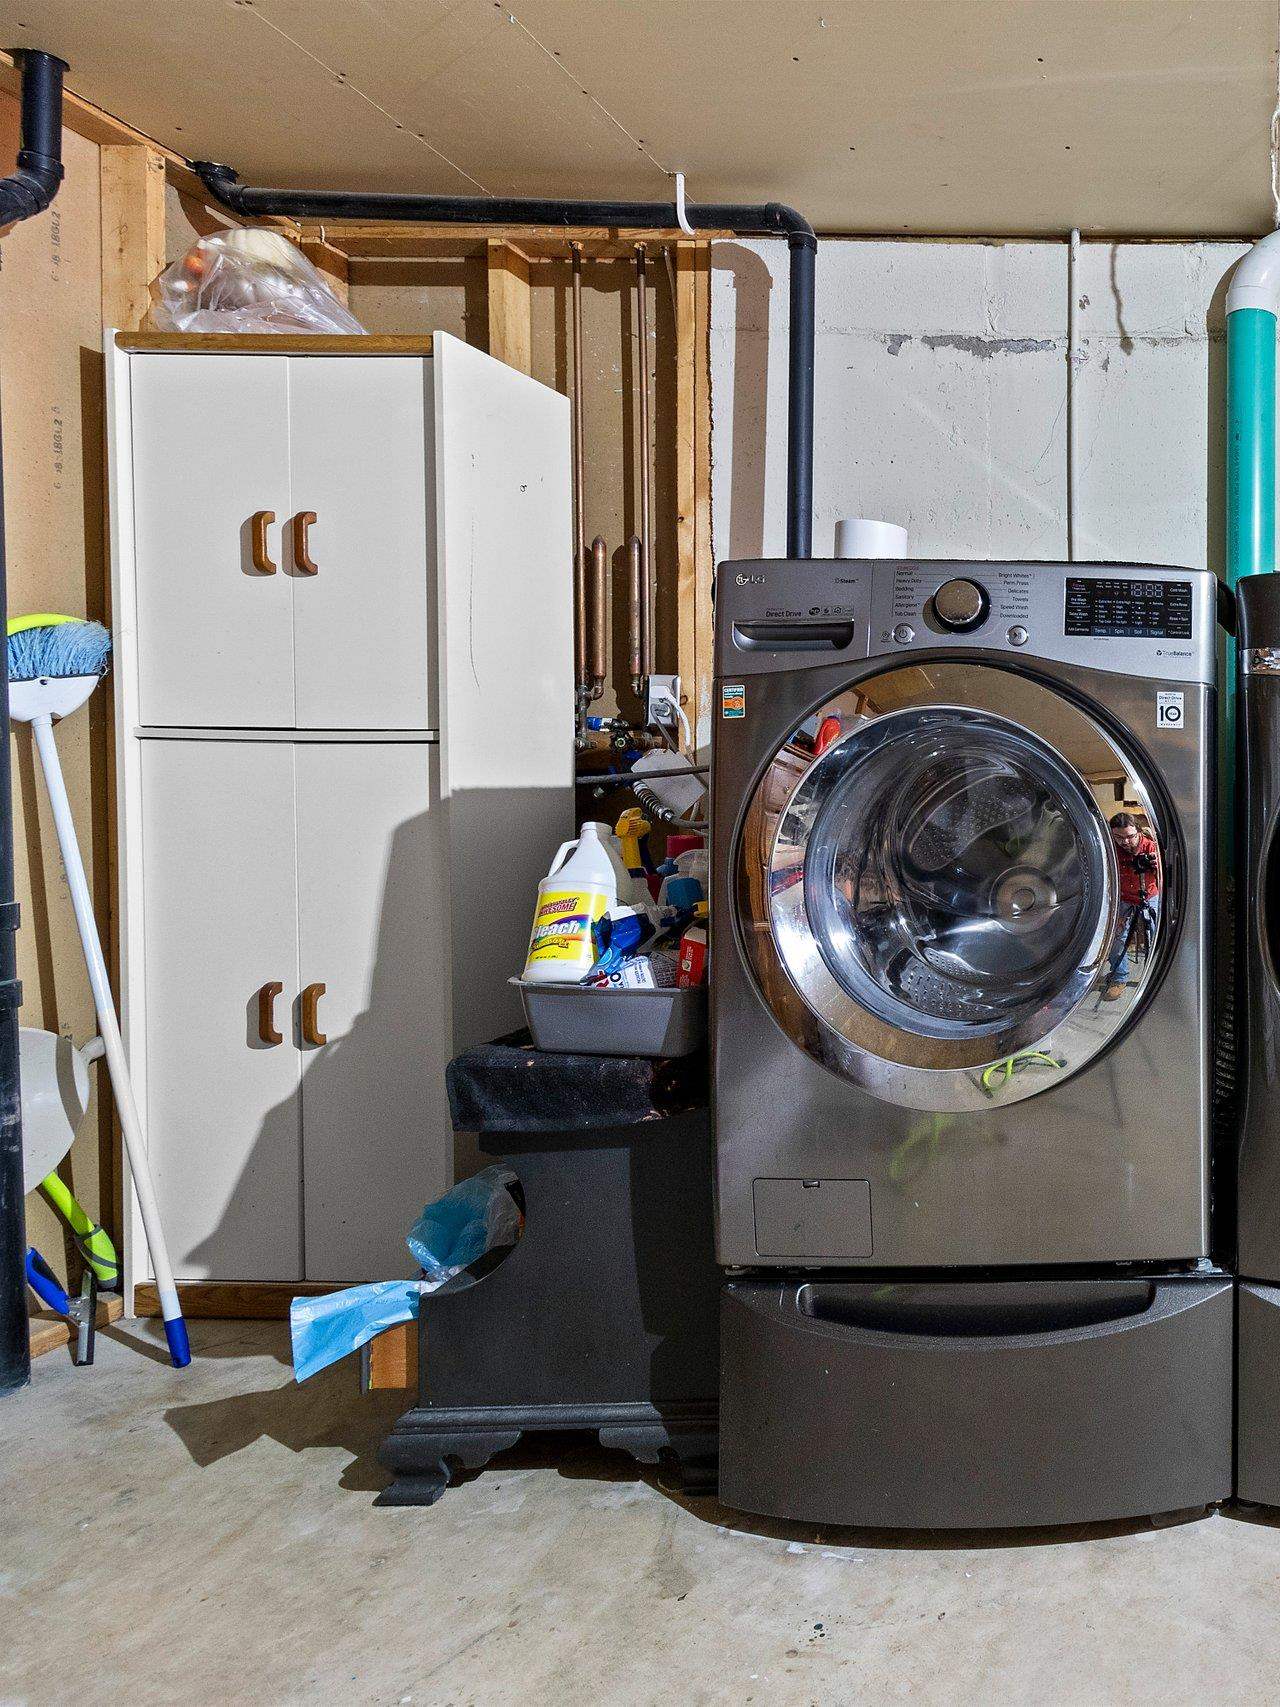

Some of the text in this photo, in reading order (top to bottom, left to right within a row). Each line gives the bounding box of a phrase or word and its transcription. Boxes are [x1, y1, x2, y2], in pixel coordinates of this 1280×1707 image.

[765, 610, 785, 618] Direct
[785, 610, 802, 618] Drive
[1159, 705, 1181, 722] 10
